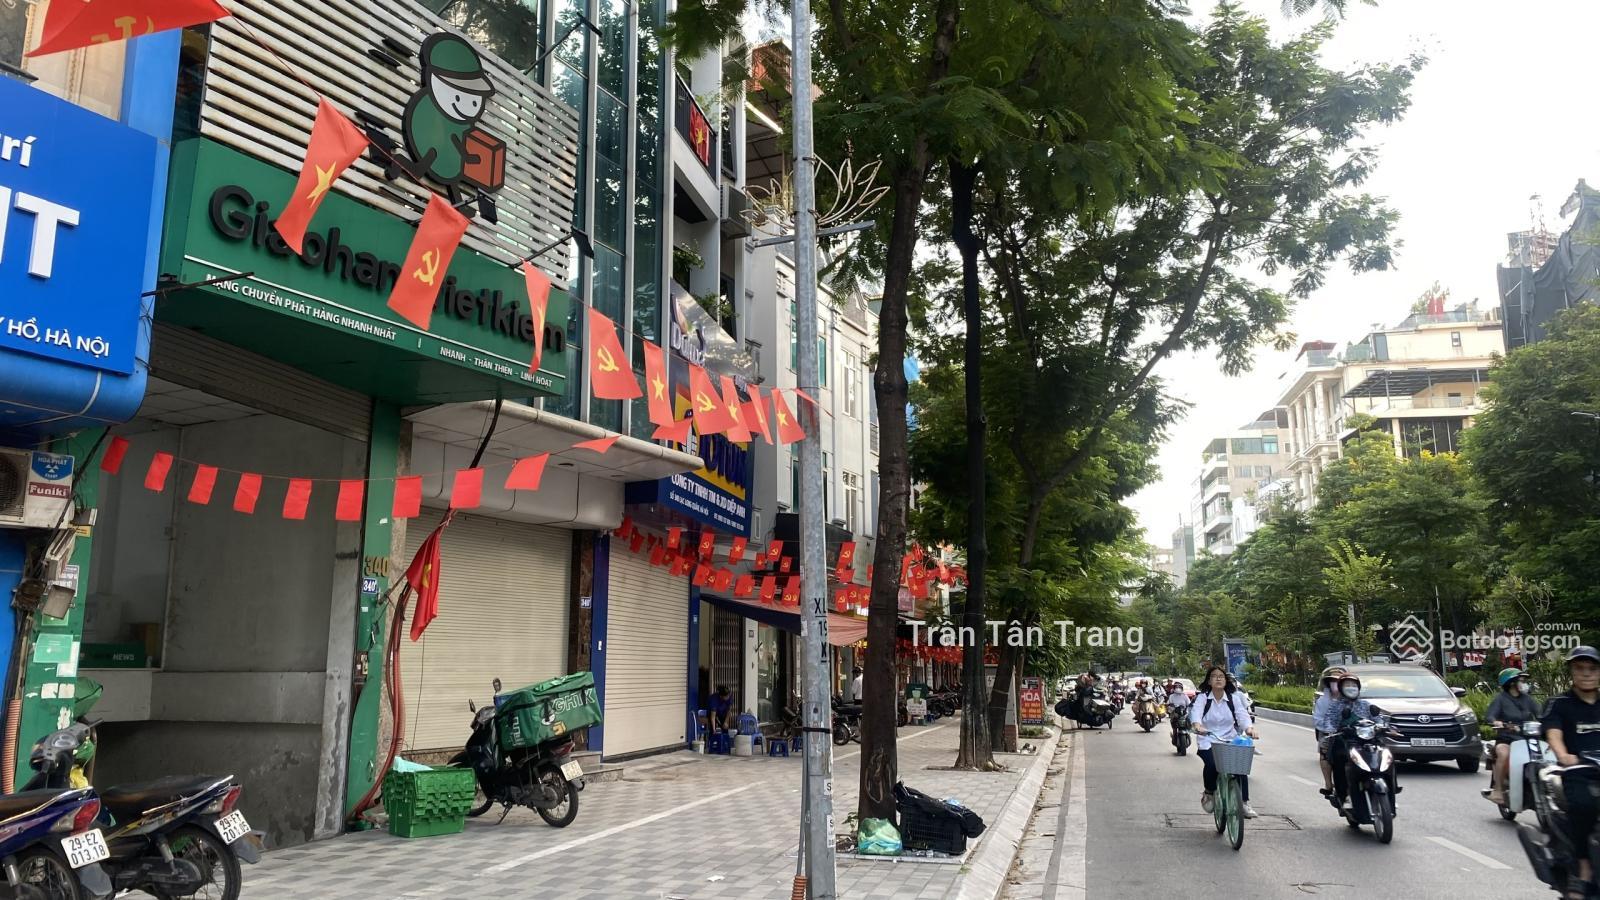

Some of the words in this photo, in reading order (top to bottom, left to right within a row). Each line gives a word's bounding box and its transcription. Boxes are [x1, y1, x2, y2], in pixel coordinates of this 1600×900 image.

[0, 133, 37, 168] rí
[284, 299, 313, 316] PHÁT
[313, 307, 340, 324] HÀNG
[341, 316, 373, 334] NHANH
[373, 324, 397, 341] NHẤT
[7, 316, 41, 343] HỒ,
[45, 327, 72, 348] HÀ
[76, 335, 110, 358] NỘI
[440, 346, 466, 362] NHANH
[30, 484, 67, 497] Funiki
[70, 844, 106, 866] 013.18
